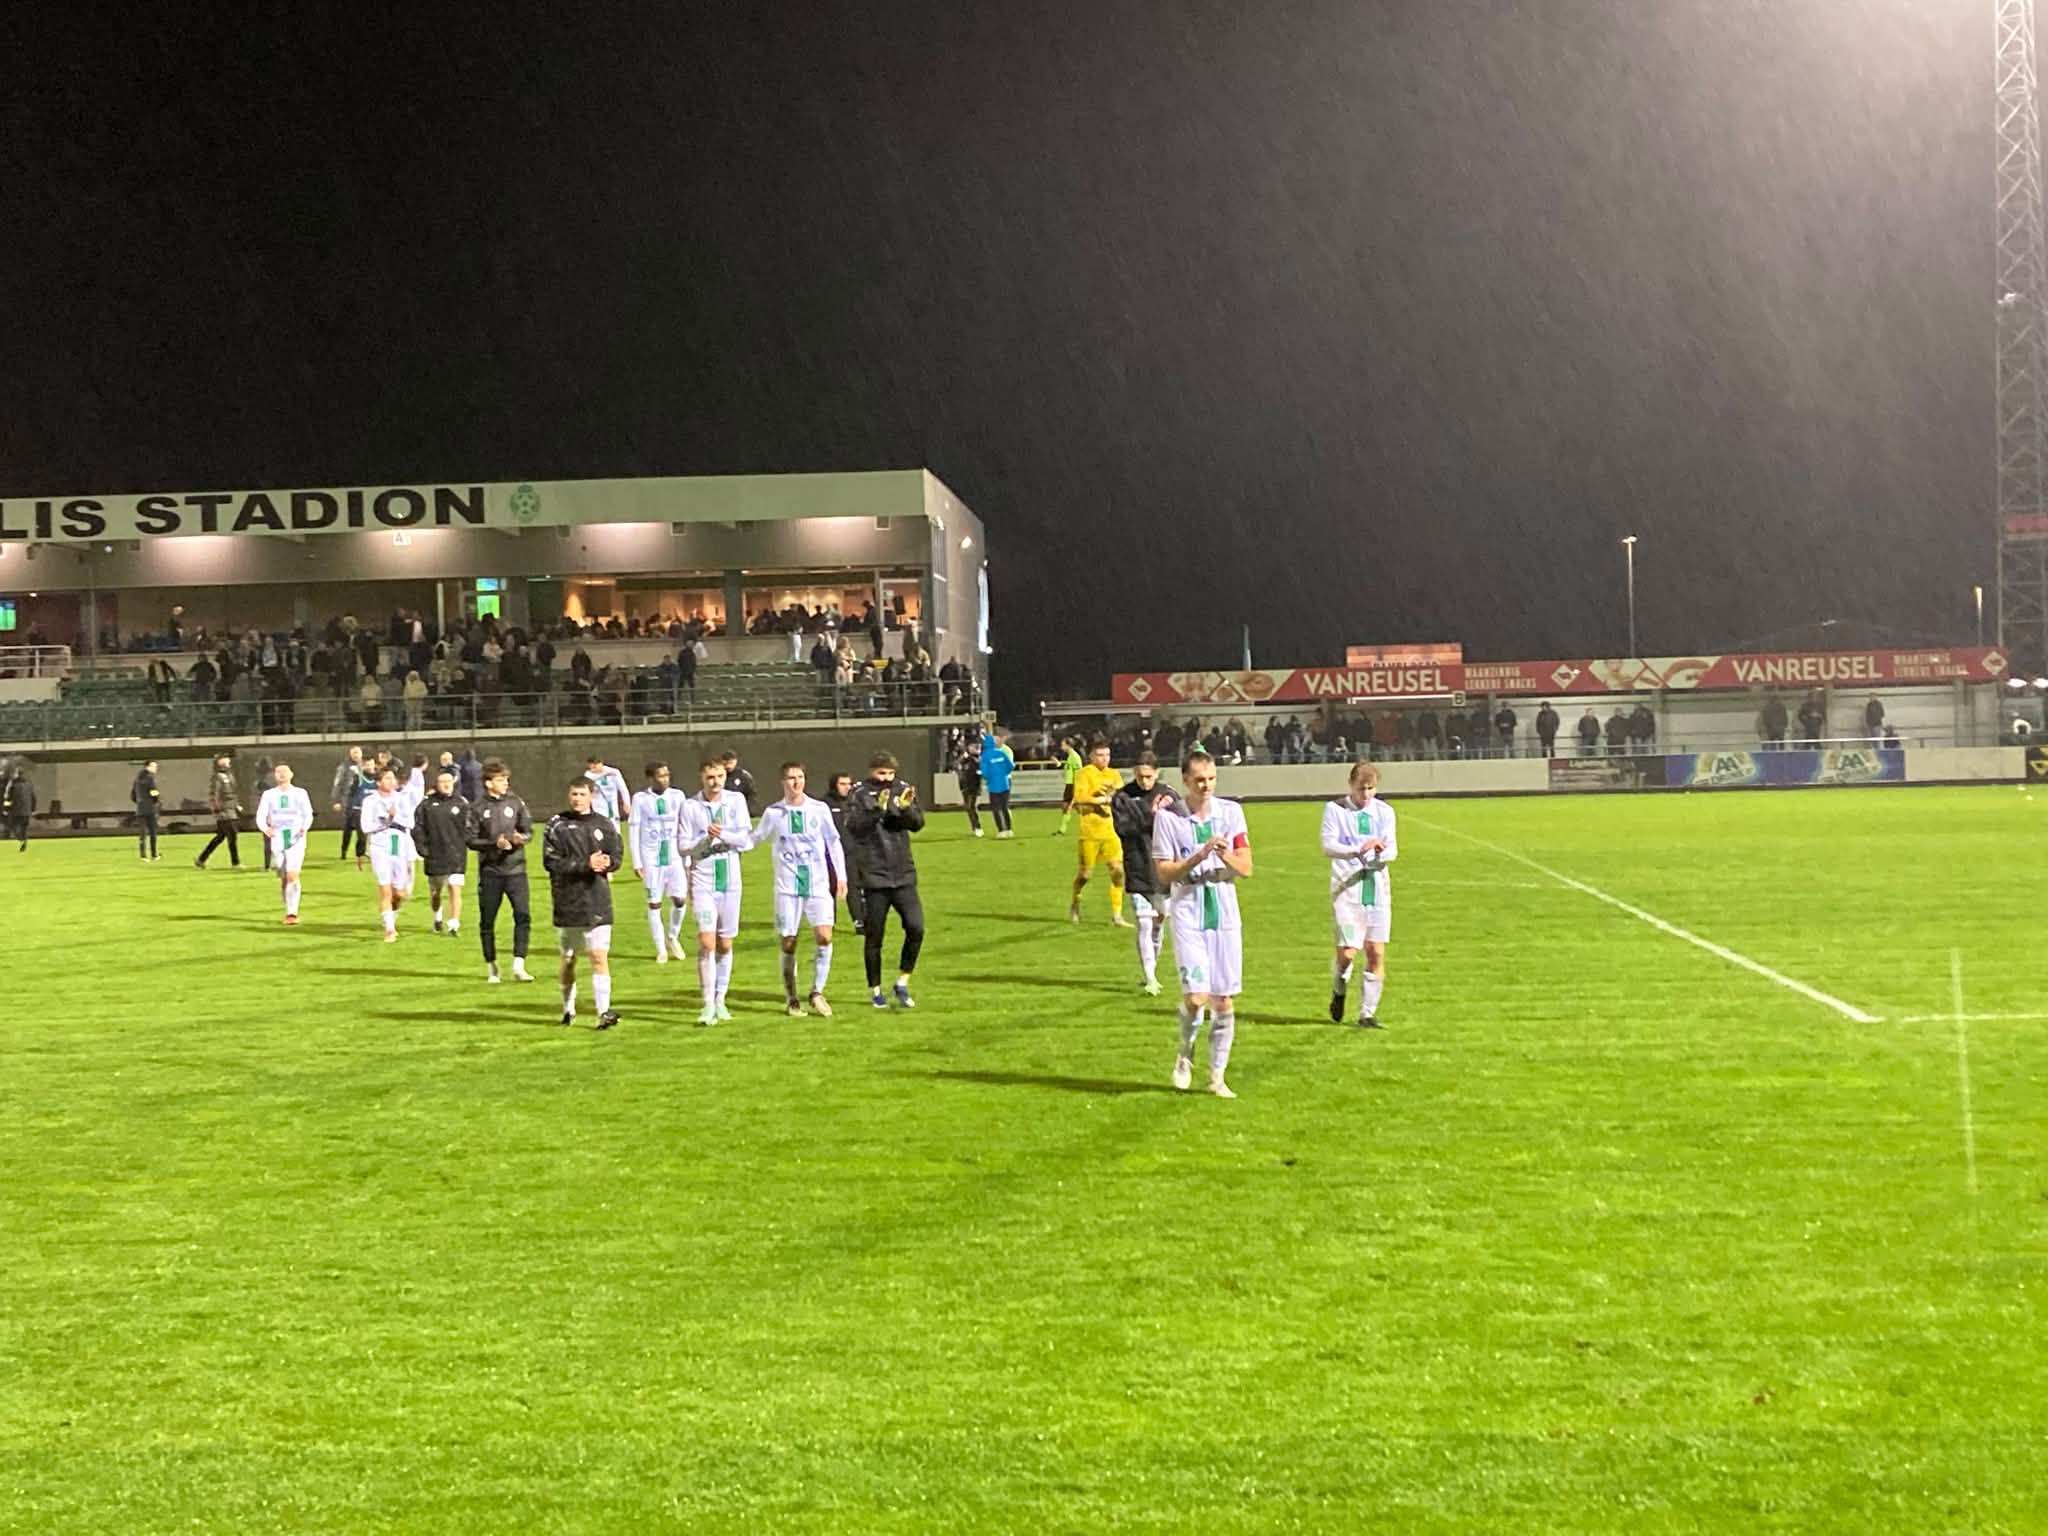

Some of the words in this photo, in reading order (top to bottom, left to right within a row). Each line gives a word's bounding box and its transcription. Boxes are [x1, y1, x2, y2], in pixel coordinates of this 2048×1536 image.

[134, 487, 485, 534] STADION
[1303, 669, 1449, 695] VANREUSEL
[1732, 656, 1883, 682] VANREUSEL
[1715, 756, 1739, 774] AA
[1840, 753, 1865, 770] AA
